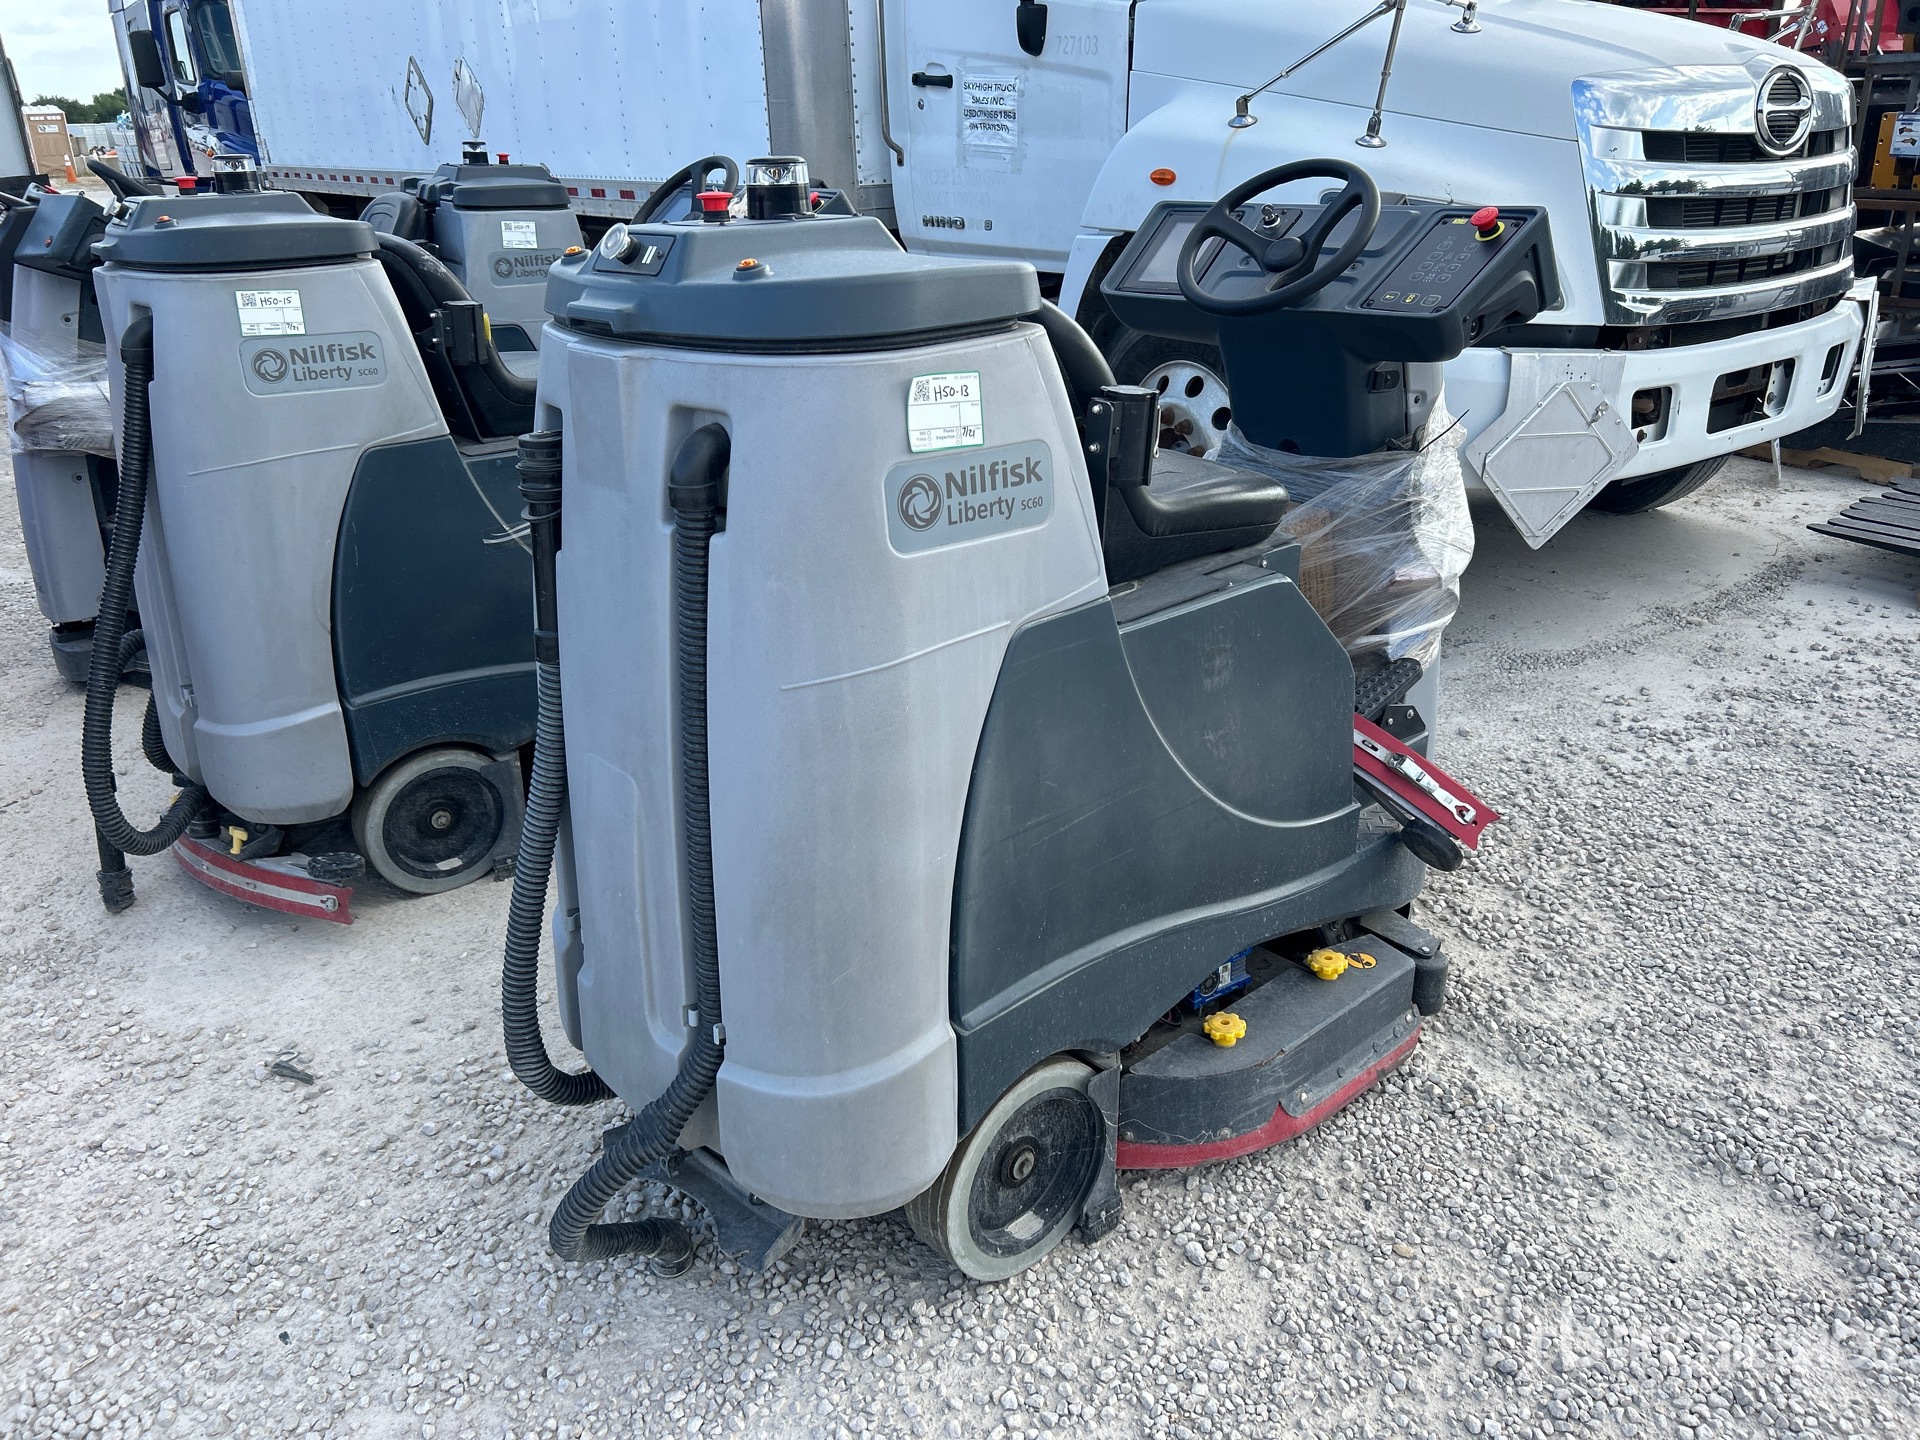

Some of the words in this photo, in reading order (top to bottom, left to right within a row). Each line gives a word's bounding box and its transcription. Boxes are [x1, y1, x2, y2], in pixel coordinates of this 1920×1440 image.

[1056, 35, 1099, 55] 727103
[963, 82, 993, 92] SKYHIGH
[994, 83, 1017, 92] TRUCK
[971, 95, 990, 105] SALES
[990, 97, 1007, 106] INC.
[922, 214, 966, 229] HINO
[515, 268, 549, 278] Liberty
[260, 296, 293, 308] H50-15
[289, 342, 376, 366] Nilfisk
[292, 365, 353, 382] Liberty
[358, 367, 379, 376] SC60
[934, 385, 970, 402] H50-13
[945, 456, 1043, 499] Nilfisk
[947, 496, 1016, 526] Liberty
[1021, 496, 1044, 511] SC60
